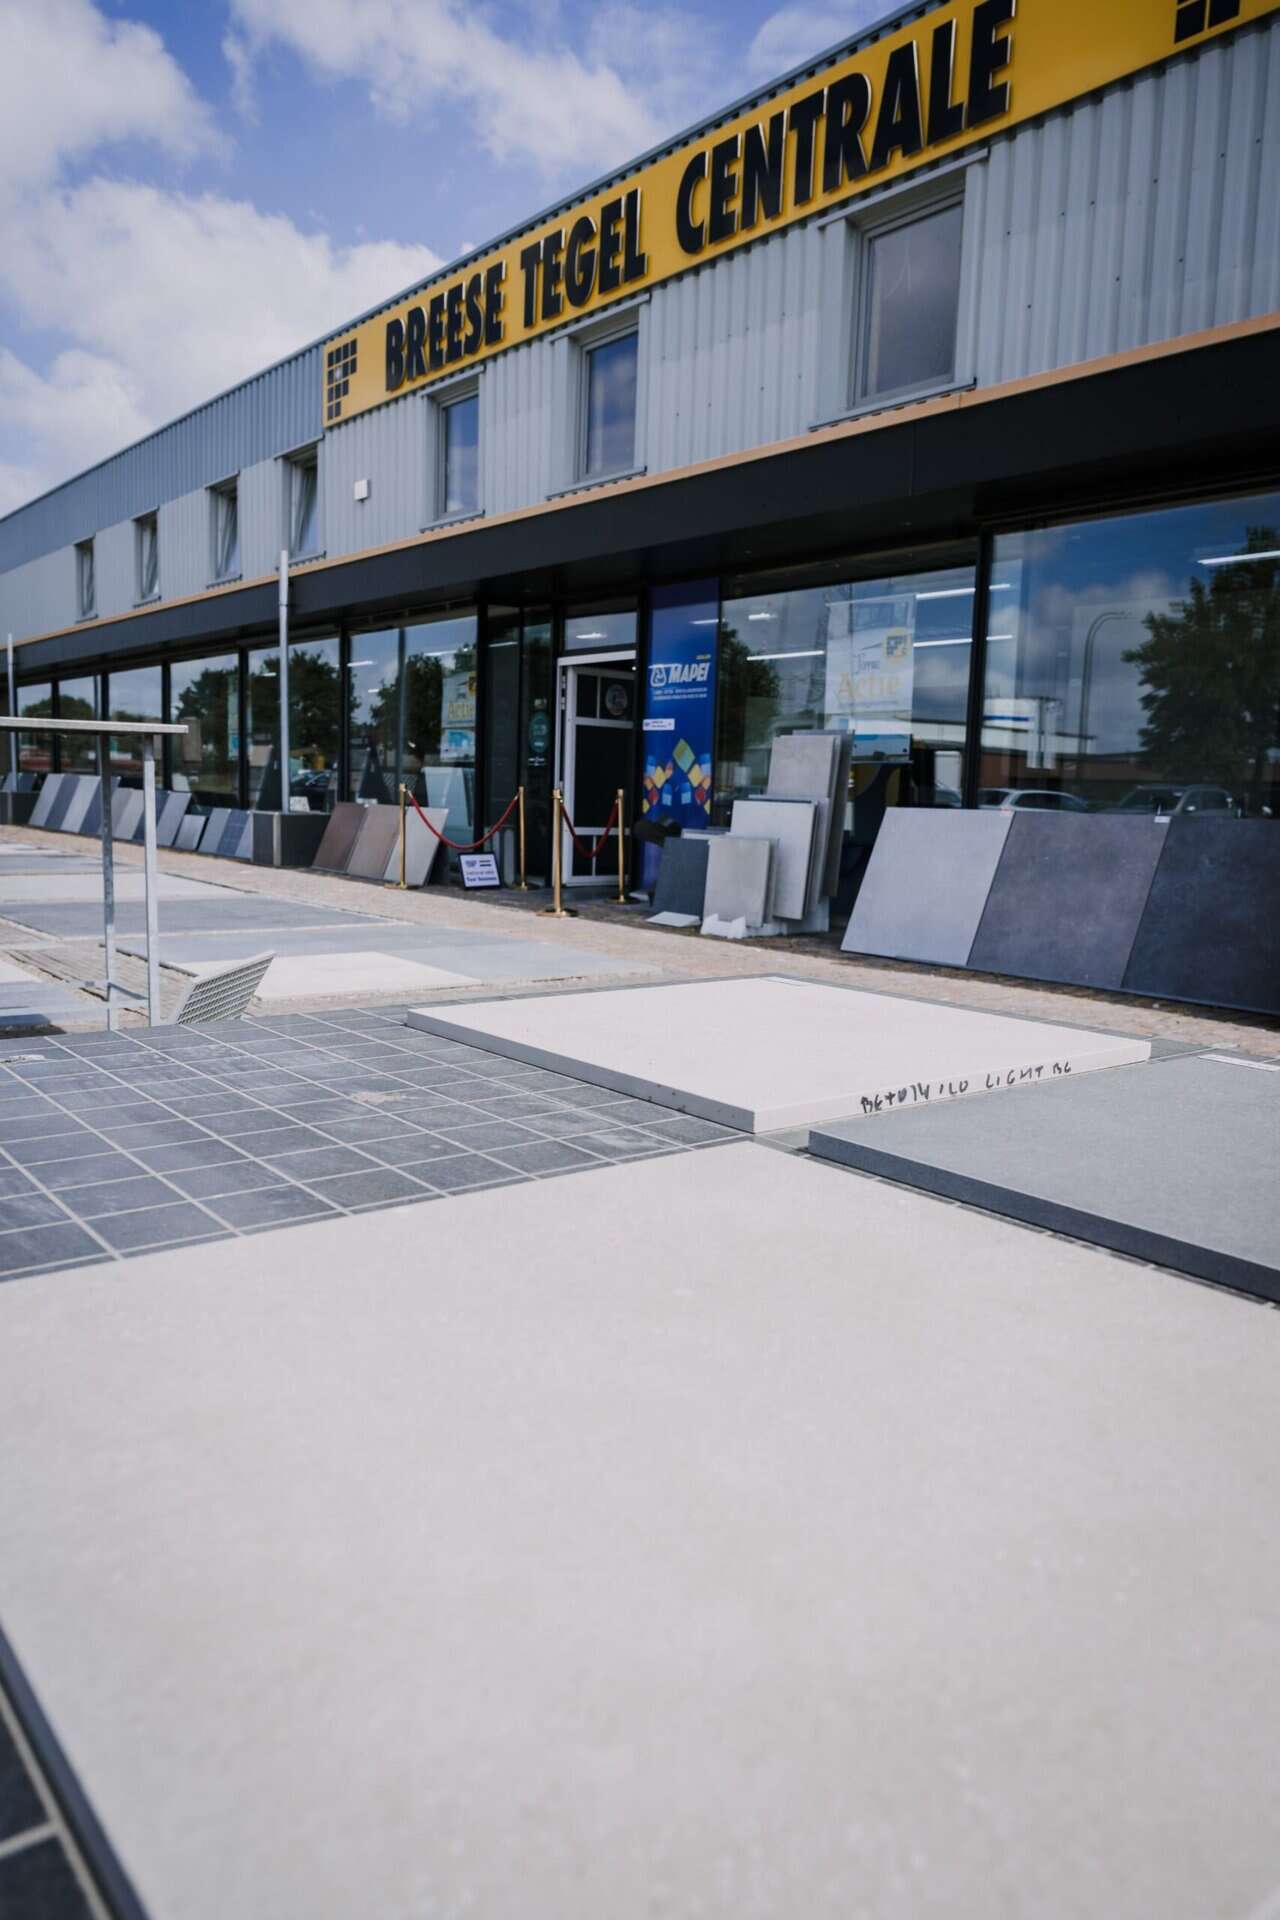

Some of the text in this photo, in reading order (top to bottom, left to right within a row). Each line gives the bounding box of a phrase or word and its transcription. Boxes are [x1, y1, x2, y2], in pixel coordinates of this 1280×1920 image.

[385, 0, 1016, 392] BREESE TEGEL CENTRALE
[668, 662, 710, 683] MAPEI
[986, 1065, 1044, 1089] LIGHT
